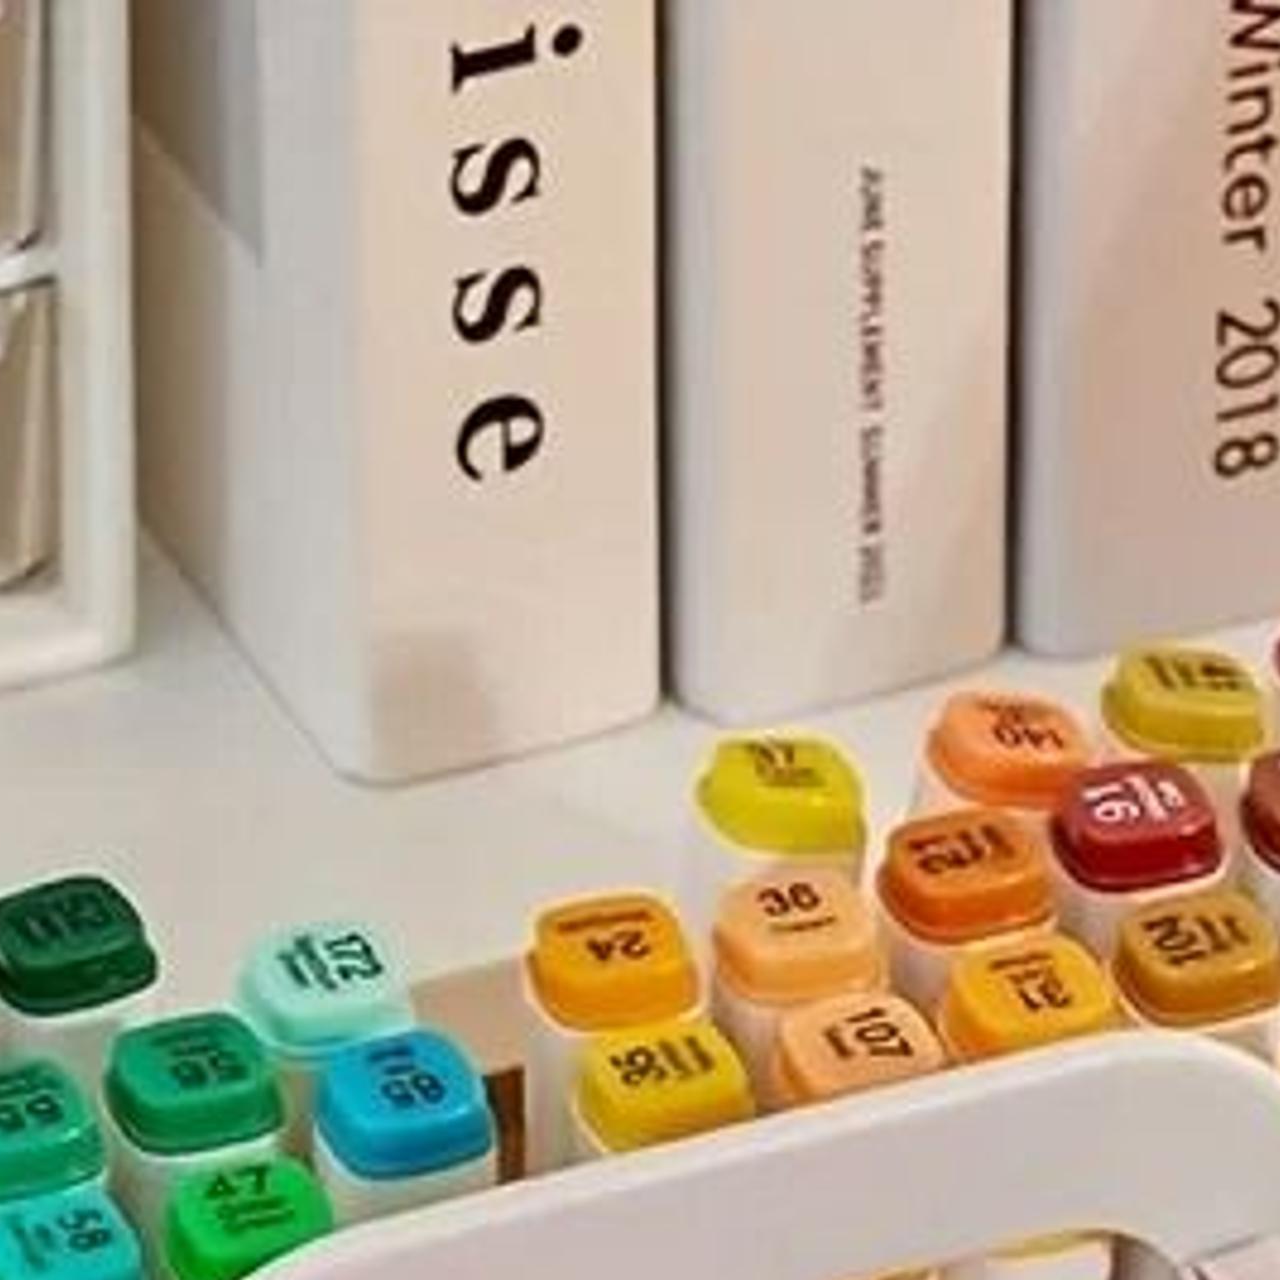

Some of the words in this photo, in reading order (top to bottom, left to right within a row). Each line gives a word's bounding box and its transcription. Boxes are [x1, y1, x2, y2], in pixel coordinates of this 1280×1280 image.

[449, 22, 584, 481] isse
[585, 929, 651, 963] 24
[845, 1006, 914, 1058] 107
[203, 1163, 271, 1200] 47
